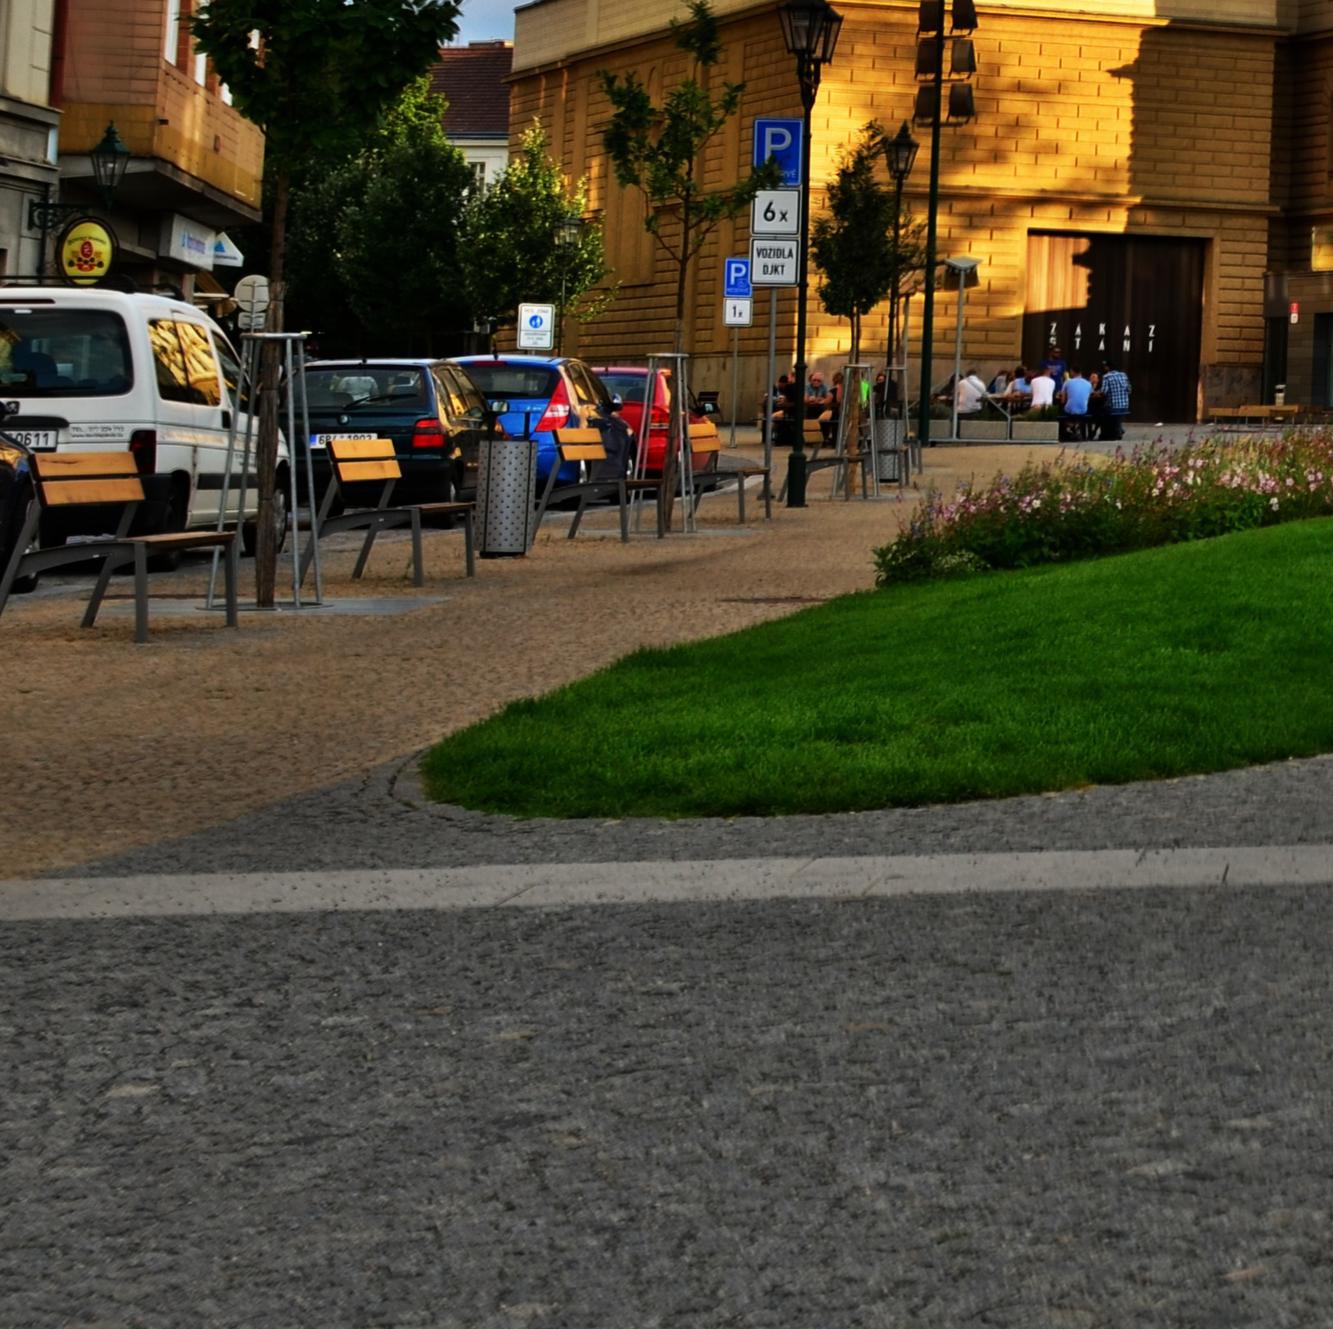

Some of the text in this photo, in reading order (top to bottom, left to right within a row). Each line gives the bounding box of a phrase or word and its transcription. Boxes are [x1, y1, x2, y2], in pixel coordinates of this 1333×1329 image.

[765, 127, 792, 165] P
[756, 247, 794, 260] VOZIDLA
[730, 263, 746, 286] P
[762, 264, 785, 275] DJKT
